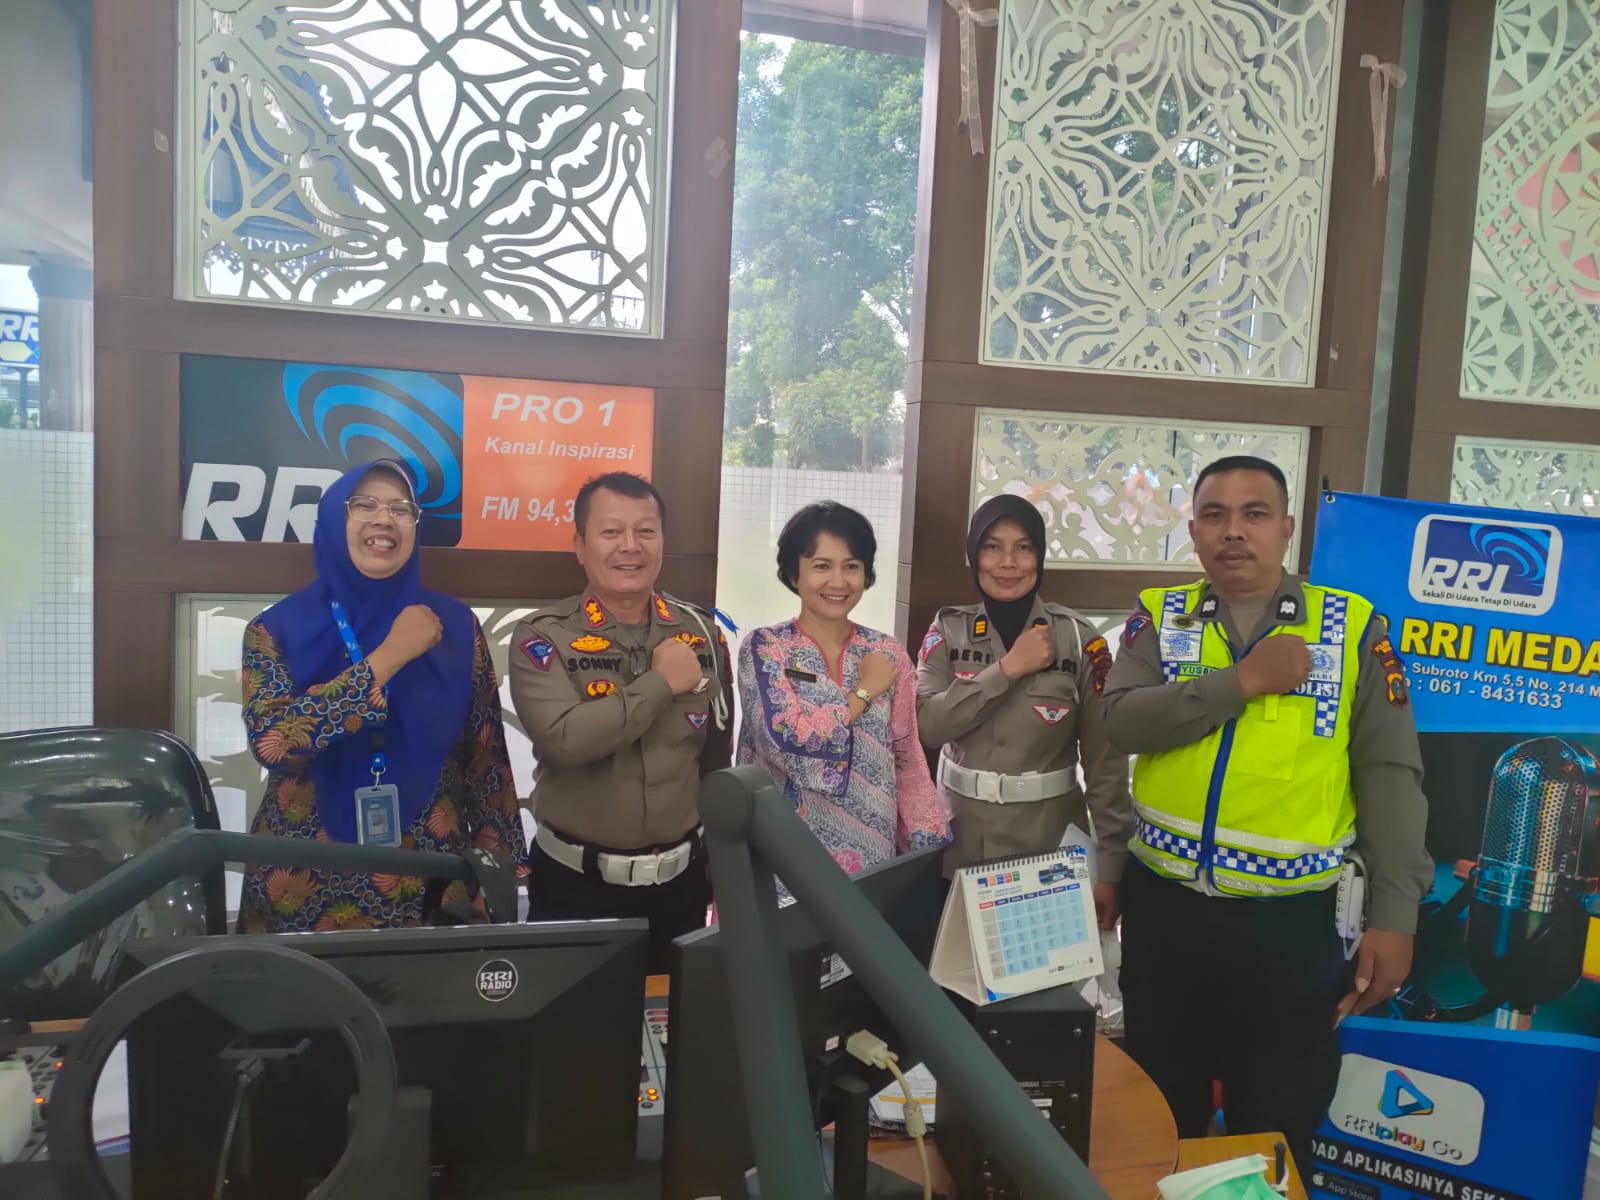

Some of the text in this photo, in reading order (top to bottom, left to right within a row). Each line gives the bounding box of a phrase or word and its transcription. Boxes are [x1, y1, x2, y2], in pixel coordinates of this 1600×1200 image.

[0, 313, 39, 342] RR
[491, 392, 616, 427] PRO 1
[484, 436, 636, 461] Kanal Inspirasi
[182, 462, 336, 544] RR
[481, 496, 520, 520] FM
[1422, 556, 1510, 592] RRI
[1446, 592, 1455, 600] Di
[1456, 593, 1479, 603] Udara
[1481, 596, 1502, 607] Tetap
[1513, 599, 1536, 609] Udara
[1400, 617, 1474, 661] RRI
[567, 656, 622, 673] SONNY
[1294, 682, 1340, 698] OLISI
[1412, 662, 1470, 680] Subroto
[1473, 669, 1499, 684] Km
[1502, 674, 1525, 688] 5,5
[1528, 677, 1553, 692] No.
[1558, 681, 1585, 695] 214
[1429, 677, 1462, 695] 061
[1480, 685, 1563, 709] 8431633
[480, 970, 513, 982] RRI
[480, 980, 512, 991] RADIO
[1432, 1140, 1463, 1161] Go
[1343, 1150, 1455, 1198] APLIKASINYA
[1327, 1182, 1348, 1195] App
